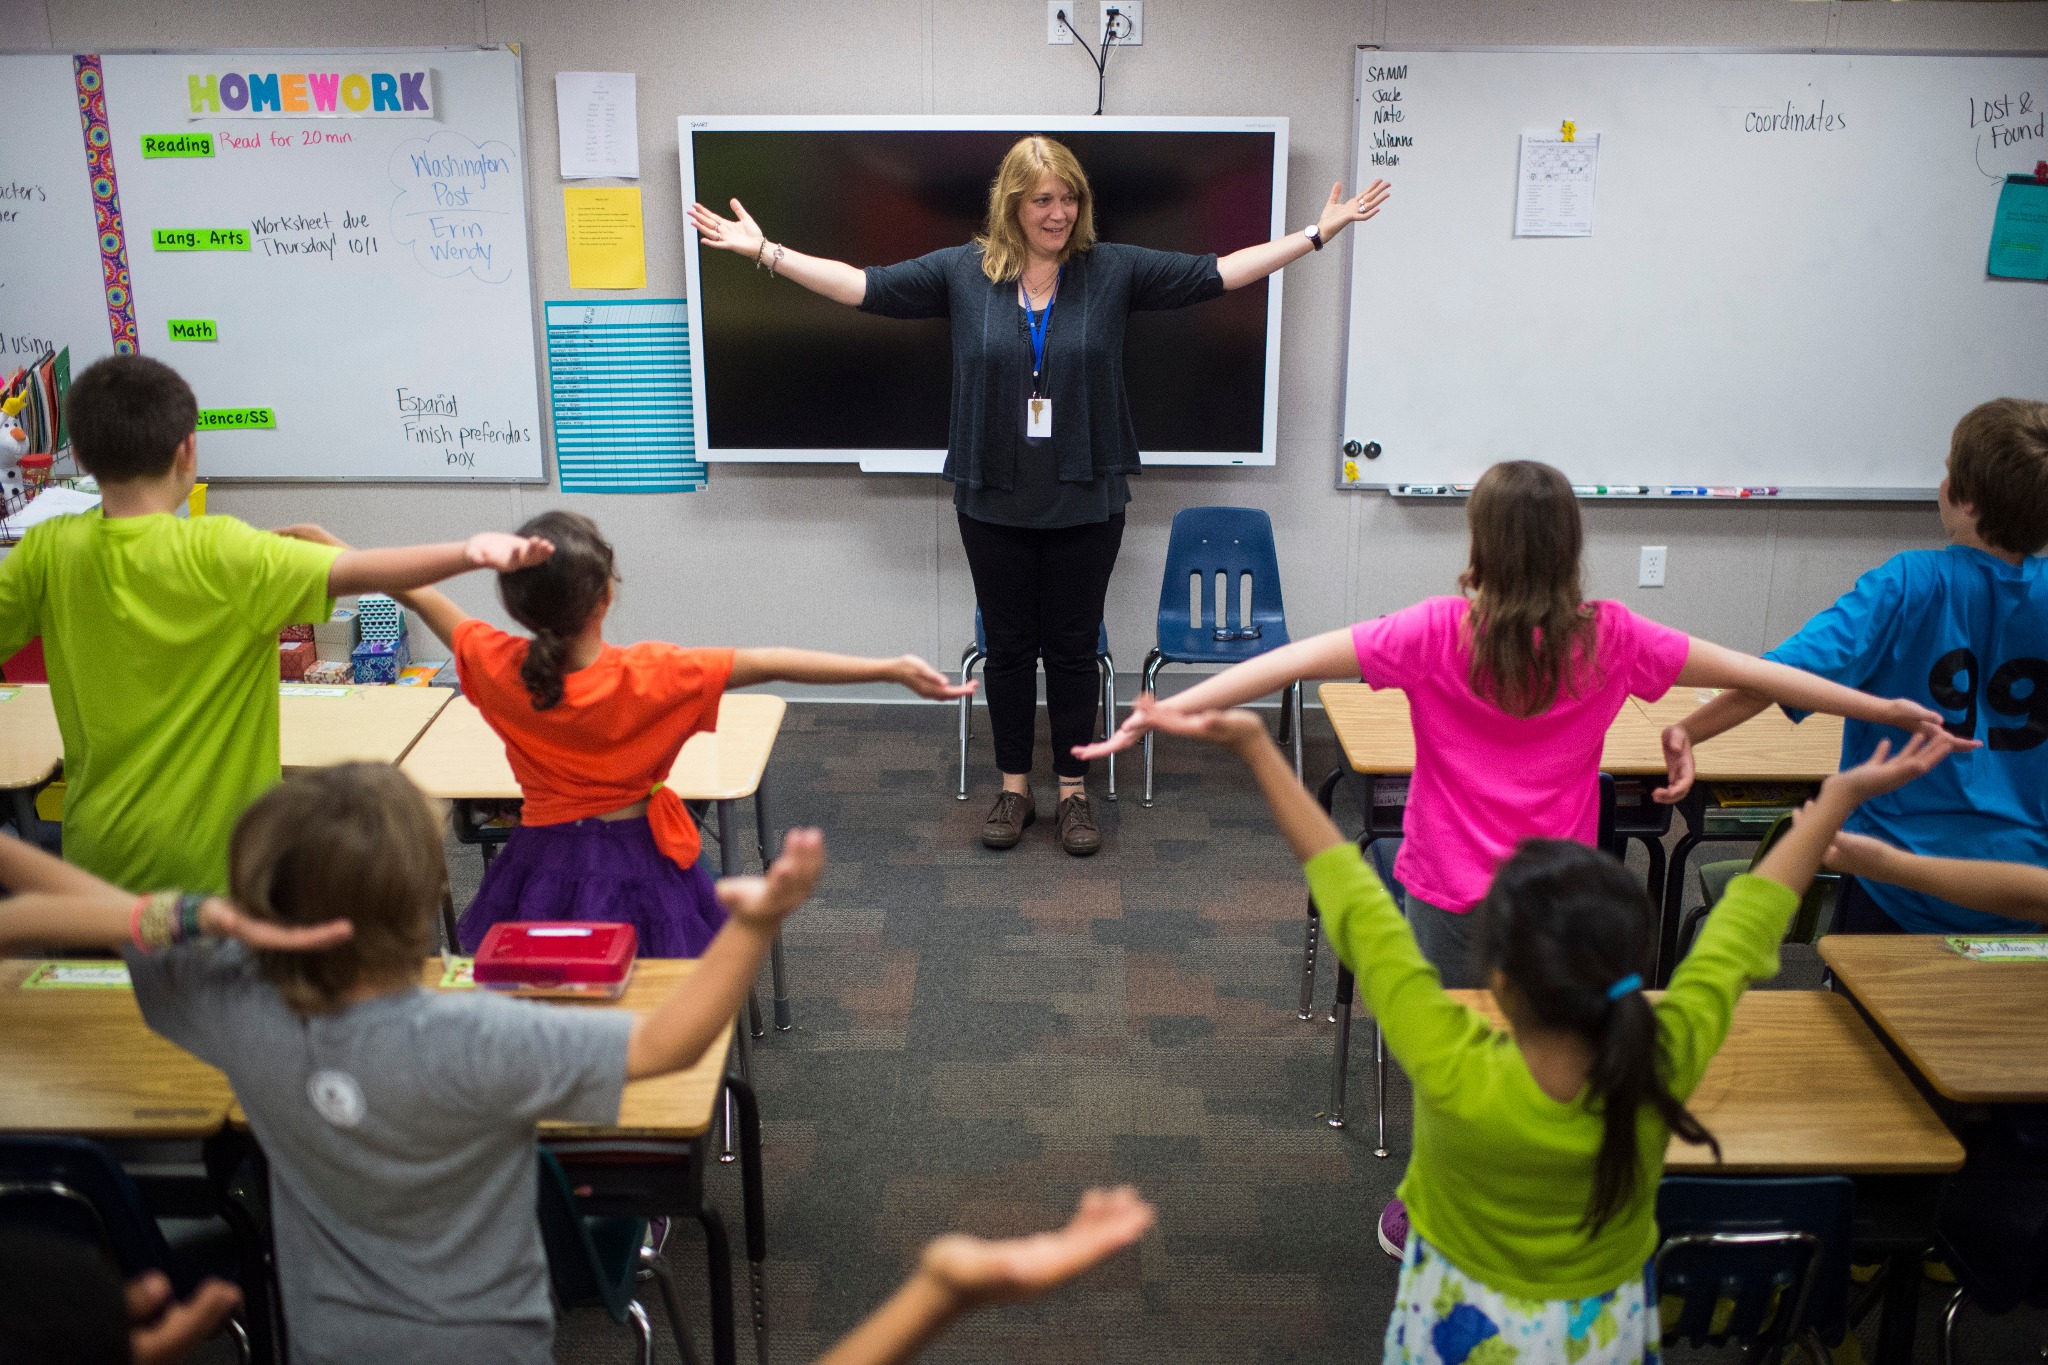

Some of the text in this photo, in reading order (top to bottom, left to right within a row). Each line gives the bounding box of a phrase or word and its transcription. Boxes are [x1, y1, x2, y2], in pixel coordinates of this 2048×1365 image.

[1365, 64, 1408, 83] SAMM
[187, 72, 430, 113] HOMEWORK
[1373, 103, 1406, 125] Nate
[1968, 90, 2034, 129] Lost &
[218, 130, 262, 150] Read
[268, 129, 294, 148] for
[302, 130, 322, 146] 20
[1990, 111, 2045, 150] Found
[145, 137, 211, 155] Reading
[410, 149, 510, 190] Washington
[431, 181, 474, 207] Post
[251, 210, 370, 235] Worksheet due
[429, 216, 484, 239] Erin
[157, 230, 244, 248] Lang. Arts
[429, 239, 492, 270] Wendy
[172, 322, 213, 339] Math
[396, 387, 458, 421] Español
[196, 410, 269, 426] cience/SS
[404, 422, 453, 444] Finish
[445, 448, 475, 470] box
[1928, 647, 2048, 752] 99
